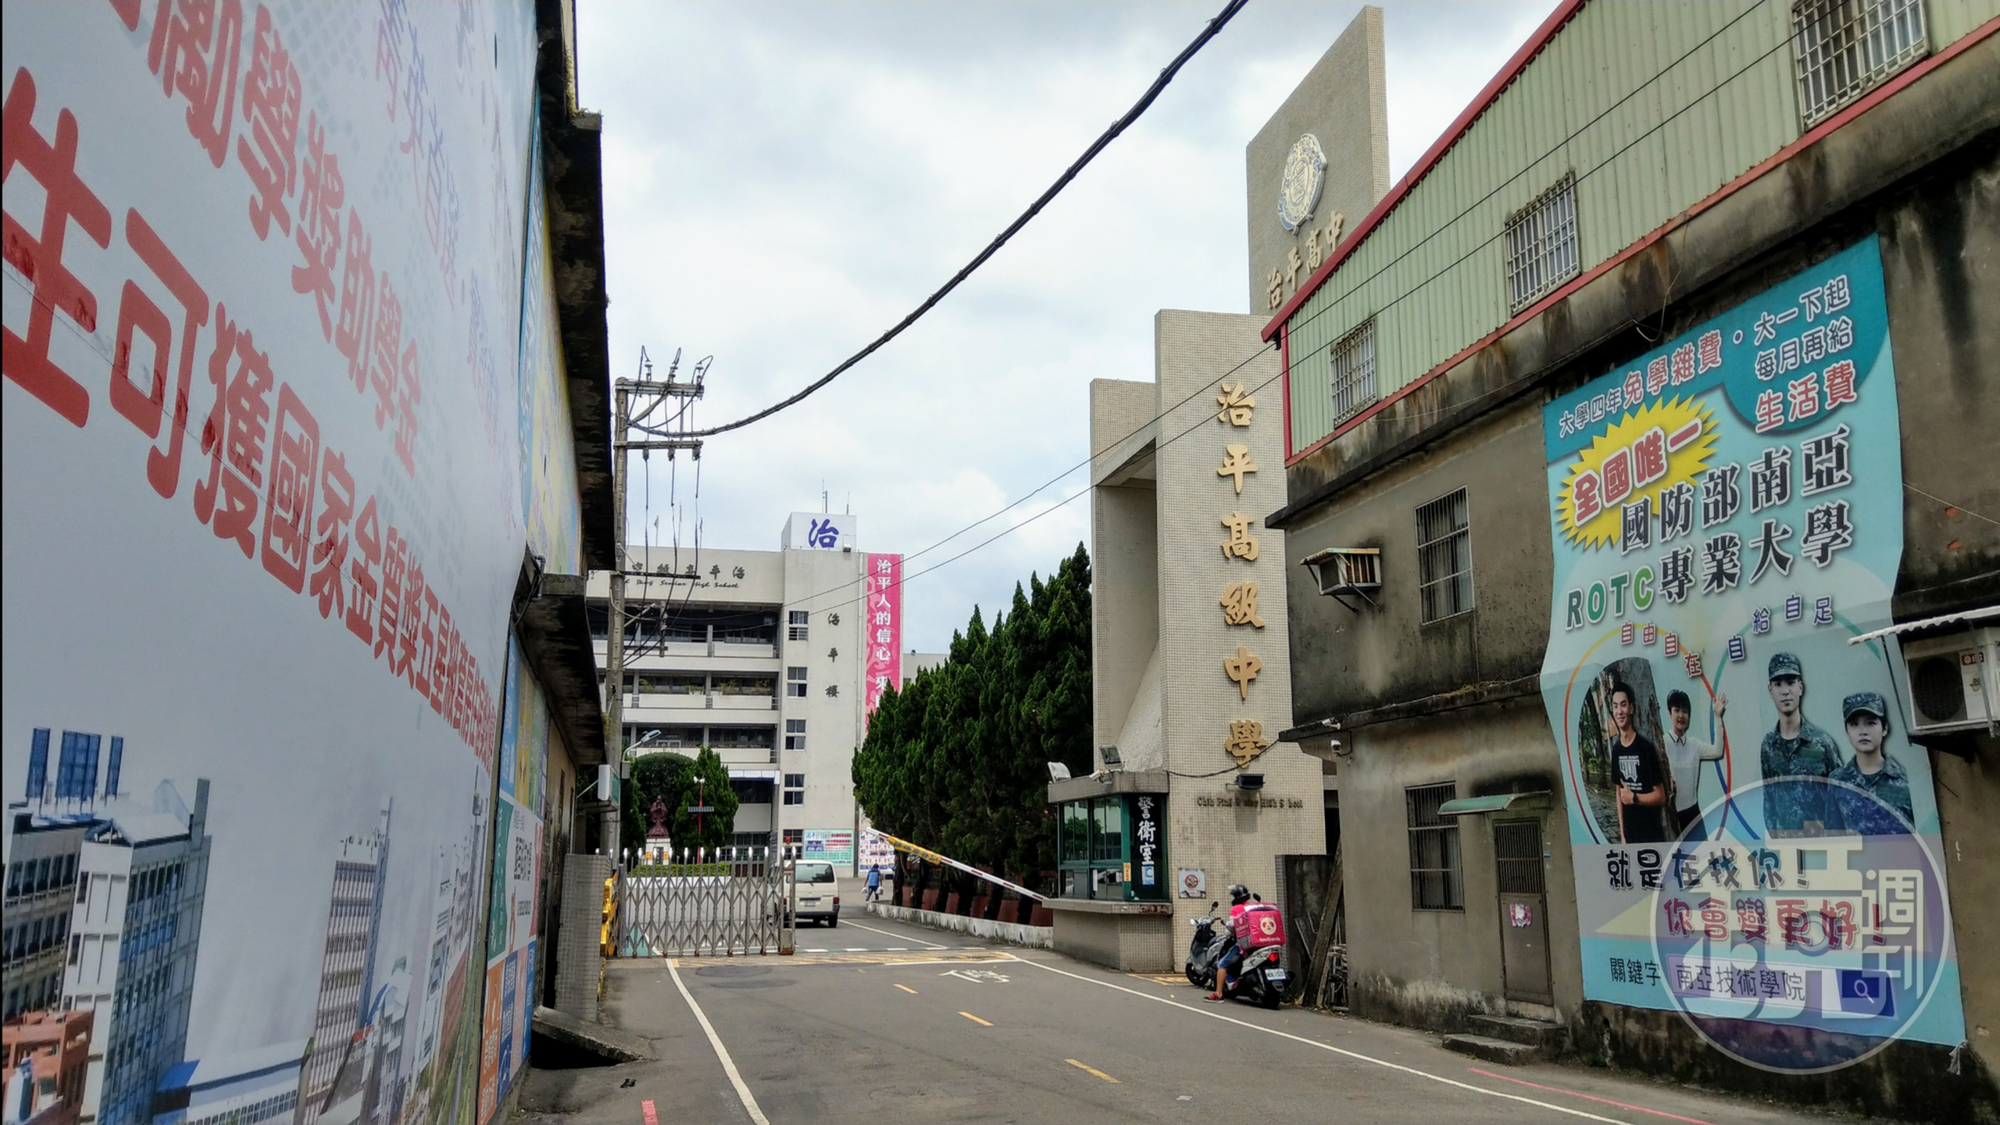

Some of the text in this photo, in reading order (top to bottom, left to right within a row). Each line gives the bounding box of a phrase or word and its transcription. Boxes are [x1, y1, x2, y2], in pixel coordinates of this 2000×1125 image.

[1267, 209, 1345, 310] 治平高中
[1754, 315, 1856, 383] 每月再給
[1754, 361, 1859, 434] 生活費
[1573, 417, 1705, 527] 全國唯一
[1620, 423, 1853, 554] 國防部南亞
[808, 518, 839, 548] 治
[875, 558, 893, 662] 治平人的信心
[1217, 382, 1269, 769] 治平高級中學
[1619, 620, 1702, 679] 自由自在
[1726, 594, 1835, 663] 自給自足
[1137, 796, 1156, 865] 警衛室
[1609, 957, 1662, 988] 關鍵字
[1674, 961, 1807, 1003] 南亞技術學院
